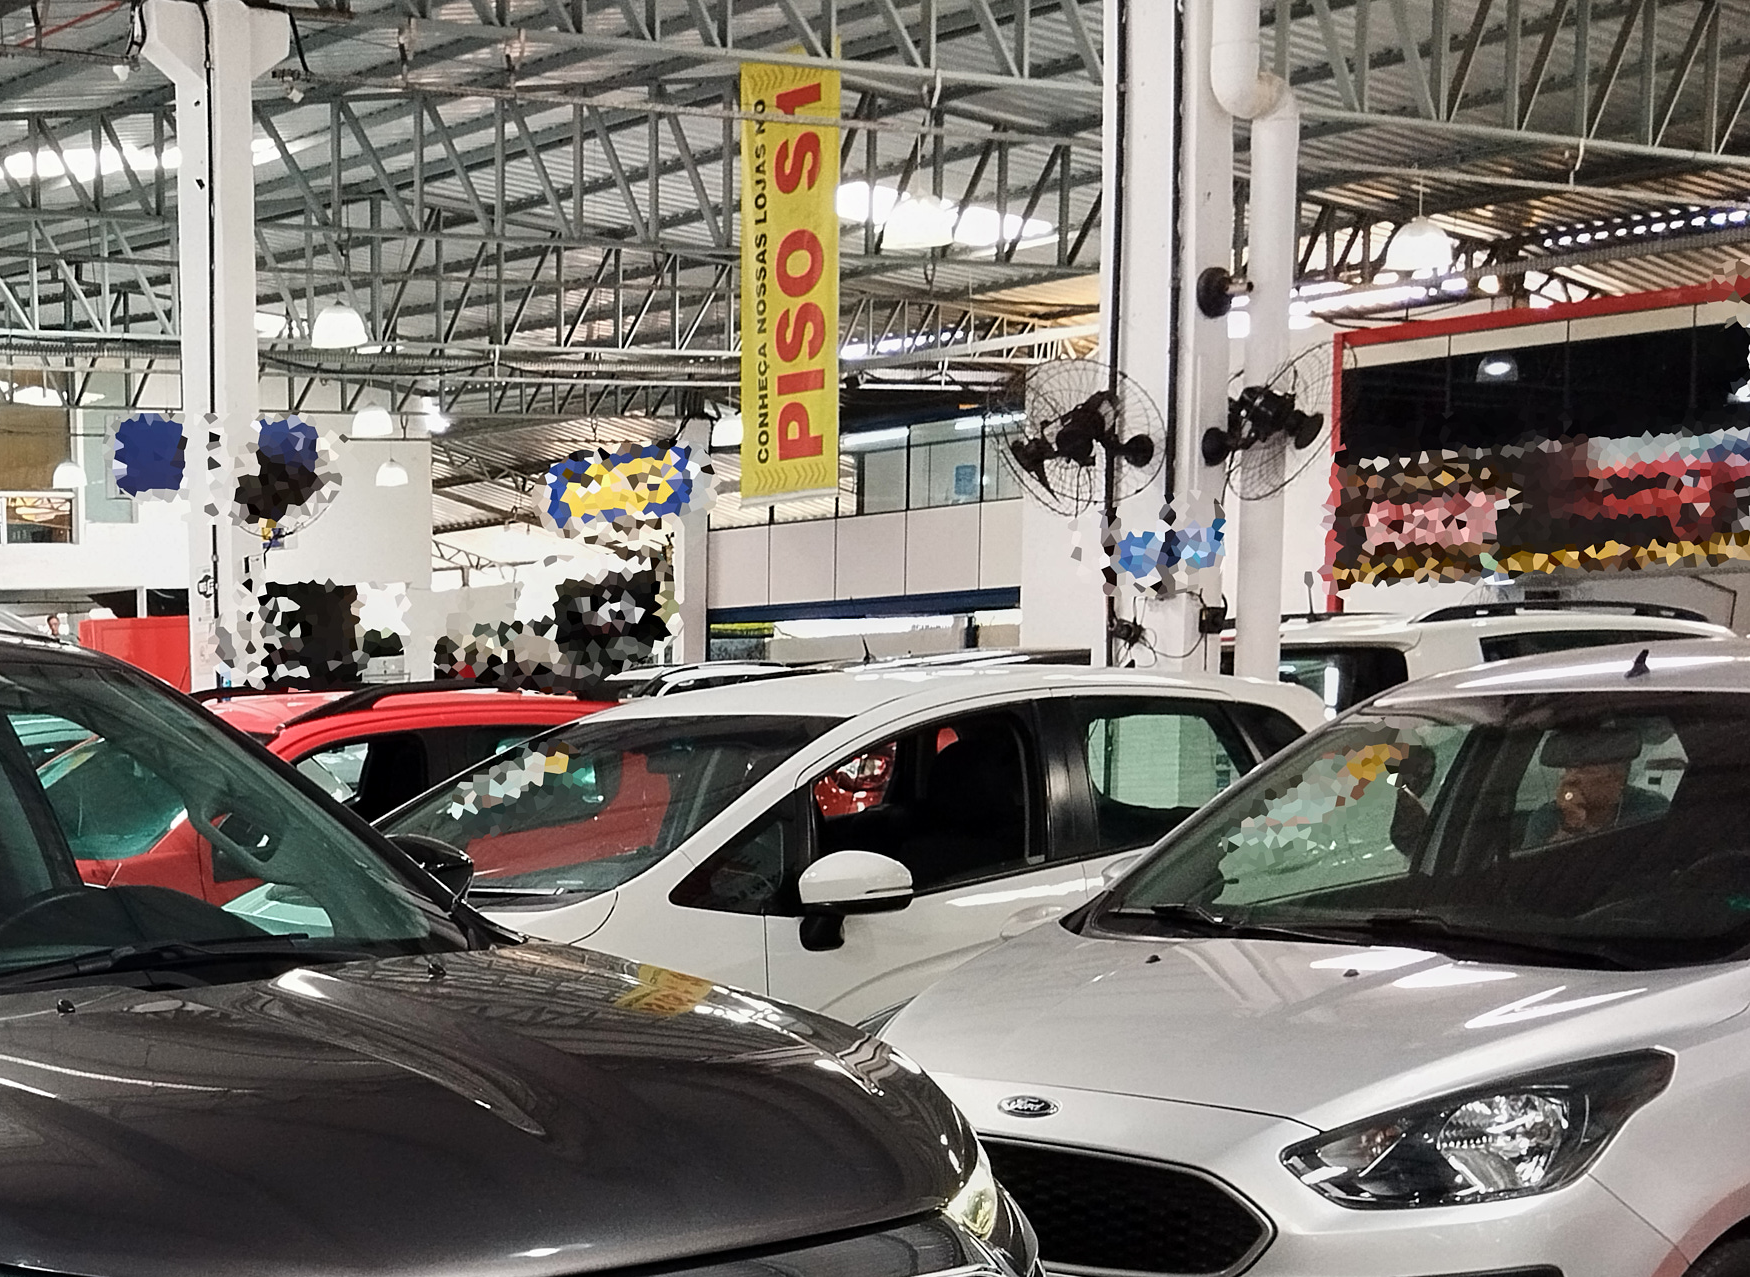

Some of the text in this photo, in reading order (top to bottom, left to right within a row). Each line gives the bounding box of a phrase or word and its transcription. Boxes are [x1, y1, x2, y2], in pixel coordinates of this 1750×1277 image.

[753, 99, 771, 464] CONHEÇA NOSSAS LOJAS NO
[773, 82, 826, 461] PISO S1
